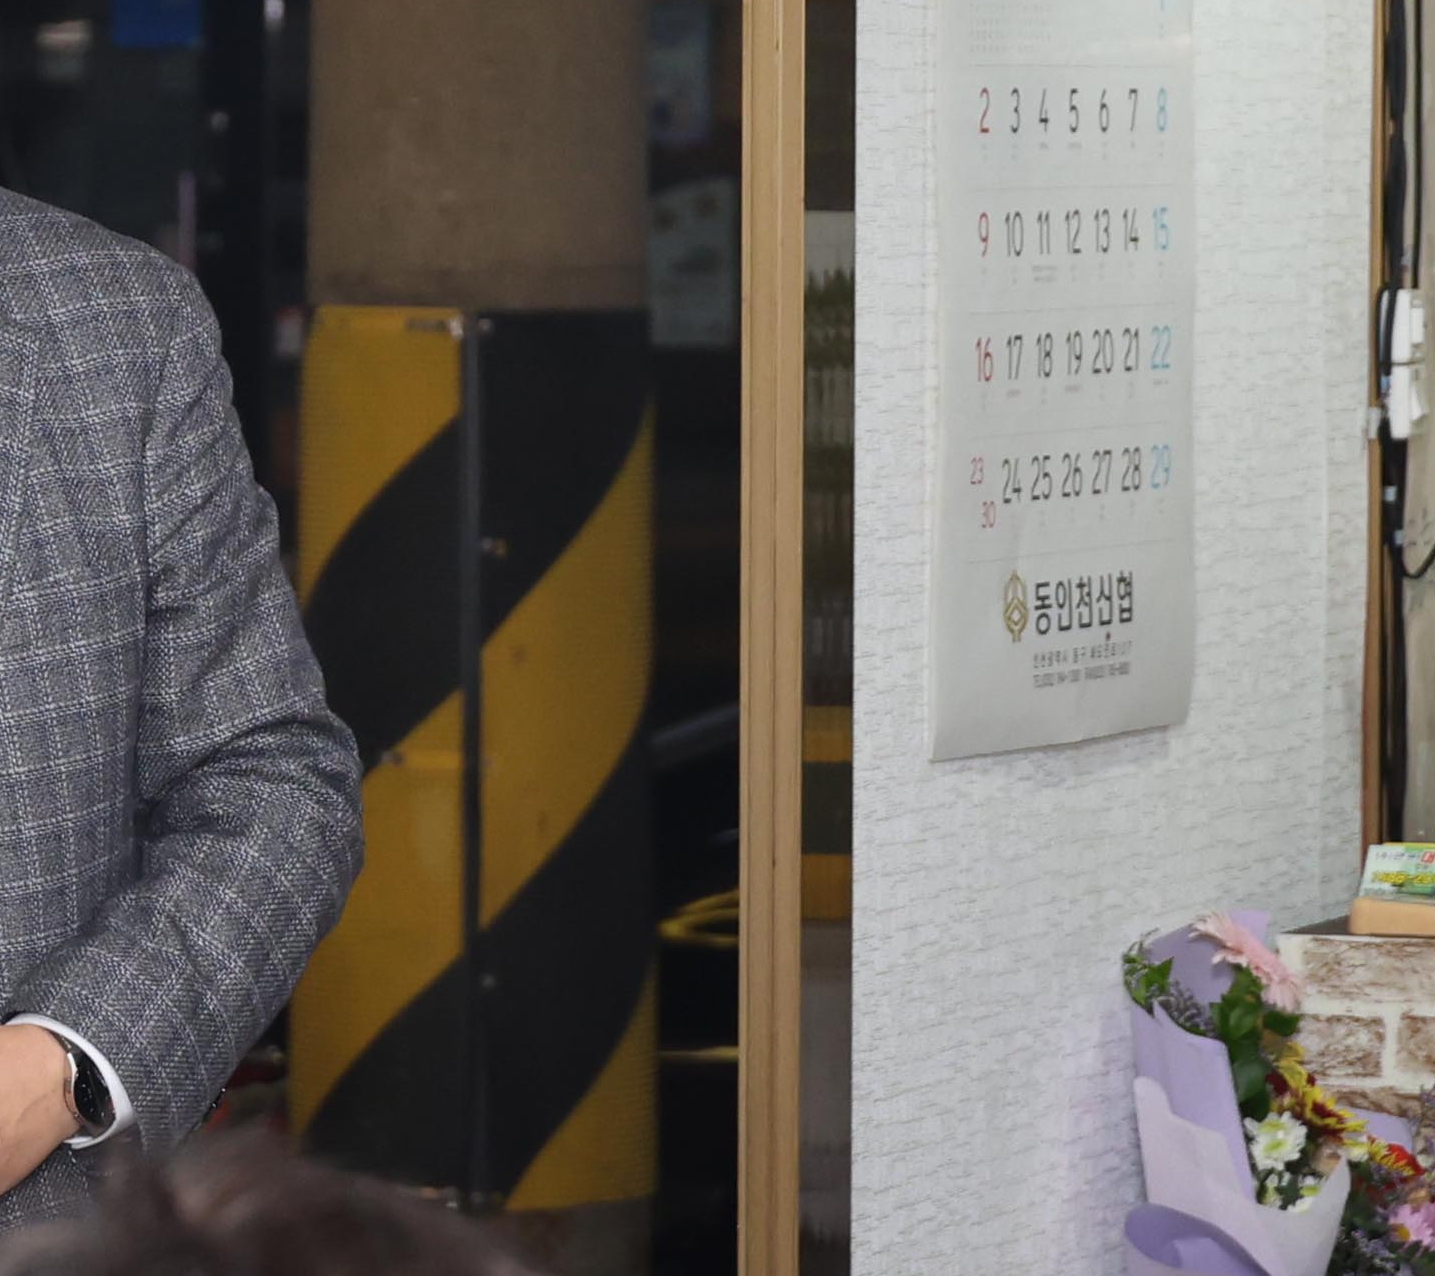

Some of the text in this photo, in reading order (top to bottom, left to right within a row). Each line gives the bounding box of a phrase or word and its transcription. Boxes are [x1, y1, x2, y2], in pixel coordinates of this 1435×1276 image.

[979, 87, 1168, 133] 2 3 4 5 6 7 8
[978, 206, 1169, 257] 9 10 11 12 13 14 15
[975, 324, 1171, 383] 16 17 18 19 20 21 22
[970, 445, 1171, 504] 23 24 25 26 27 28 29
[1033, 570, 1133, 635] 동인천신협
